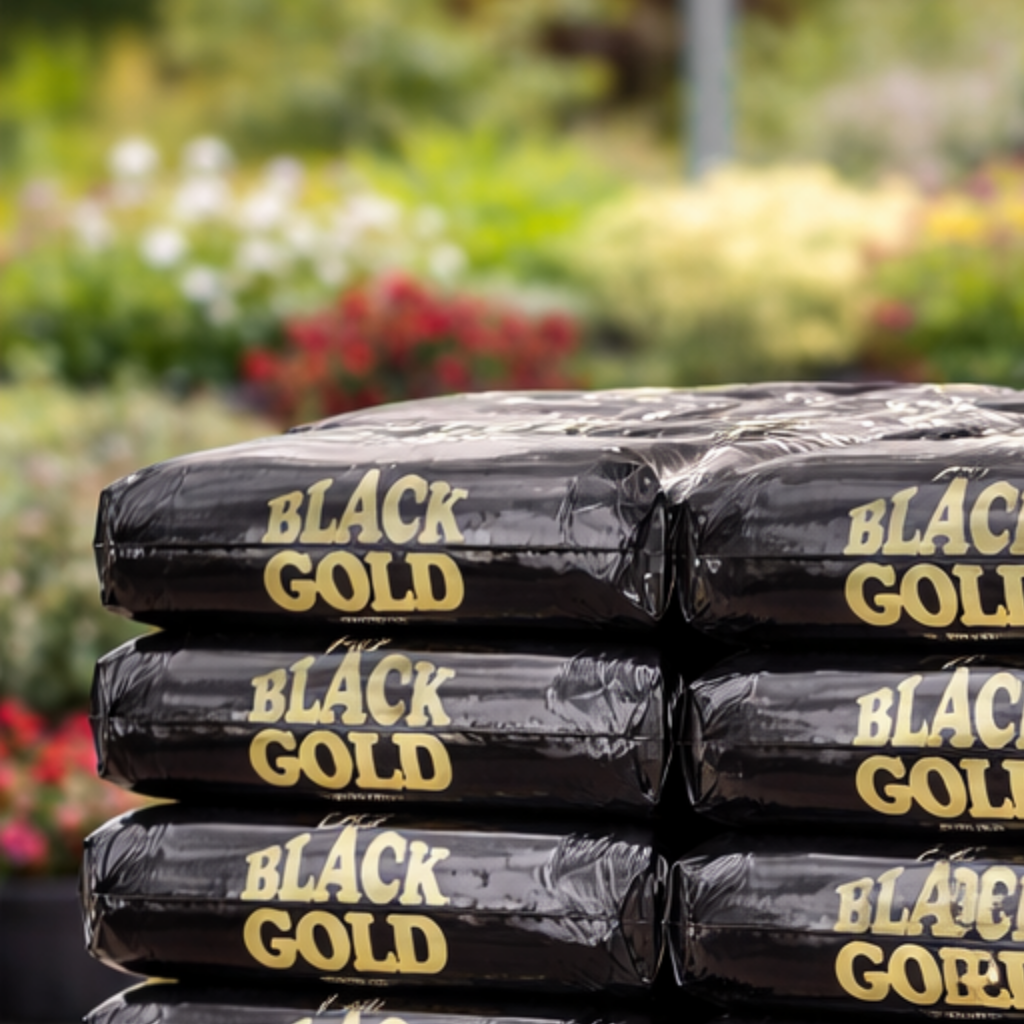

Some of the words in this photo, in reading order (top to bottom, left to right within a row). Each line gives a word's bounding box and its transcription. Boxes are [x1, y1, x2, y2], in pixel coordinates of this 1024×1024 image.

[262, 469, 469, 544] BLACK
[263, 549, 465, 612] GOLD
[247, 652, 456, 727] BLACK
[249, 728, 453, 792] GOLD
[240, 825, 448, 905] BLACK
[243, 907, 448, 974] GOLD
